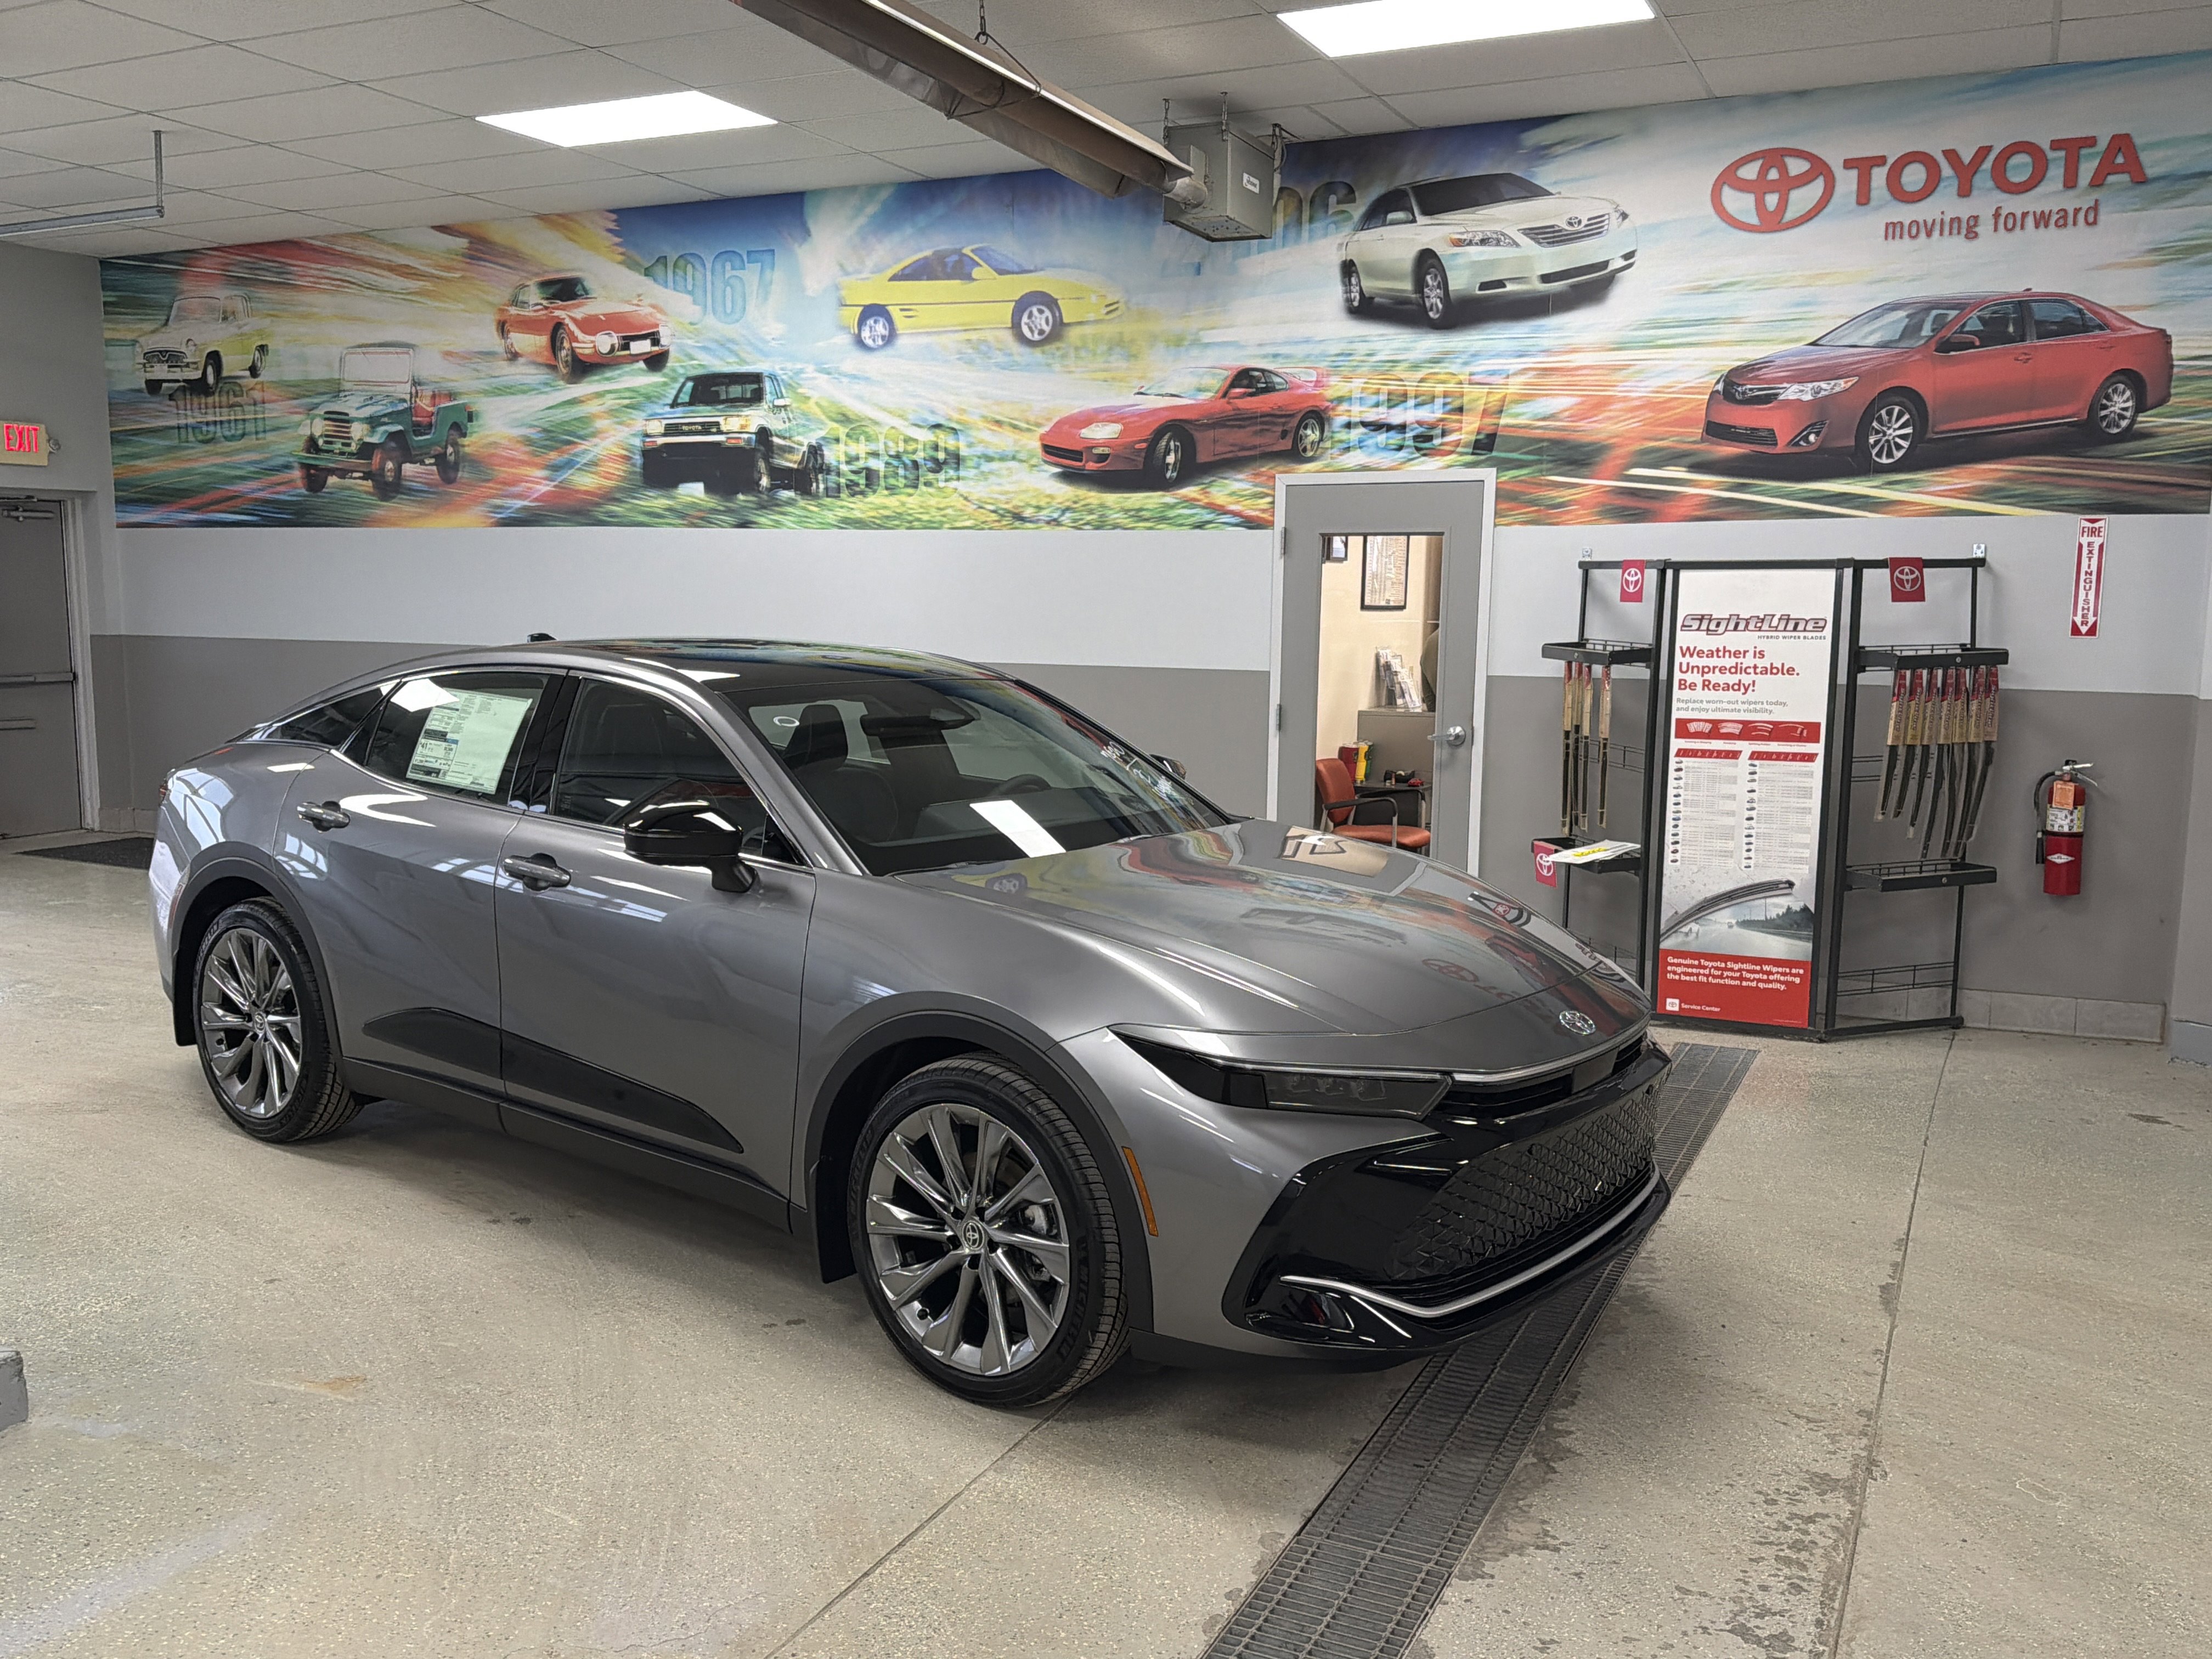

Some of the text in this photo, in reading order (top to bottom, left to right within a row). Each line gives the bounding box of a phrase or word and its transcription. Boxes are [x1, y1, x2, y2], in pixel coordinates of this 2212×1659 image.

[1843, 133, 2147, 206] TOYOTA
[1884, 198, 2100, 240] moving forward
[644, 249, 775, 325] 1967
[168, 380, 267, 444] 1961
[4, 423, 40, 453] EXIT
[820, 423, 961, 500] 1989
[2081, 526, 2103, 538] FIRE
[2080, 541, 2095, 627] EXTINGUISHER
[1680, 613, 1827, 636] SightLine
[1679, 646, 1765, 659] Weather is
[1679, 662, 1800, 677] Unpredictable.
[1678, 678, 1756, 695] Be Ready!
[1667, 956, 1699, 965] Genuine
[1700, 959, 1725, 968] Toyota
[1726, 962, 1761, 970] Sightline
[1762, 964, 1790, 973] Wipers
[1667, 966, 1709, 974] engineered
[1741, 971, 1768, 980] Toyota
[1769, 974, 1800, 984] offering
[1680, 974, 1697, 982] best
[1708, 977, 1740, 985] function
[1757, 981, 1787, 991] quality.
